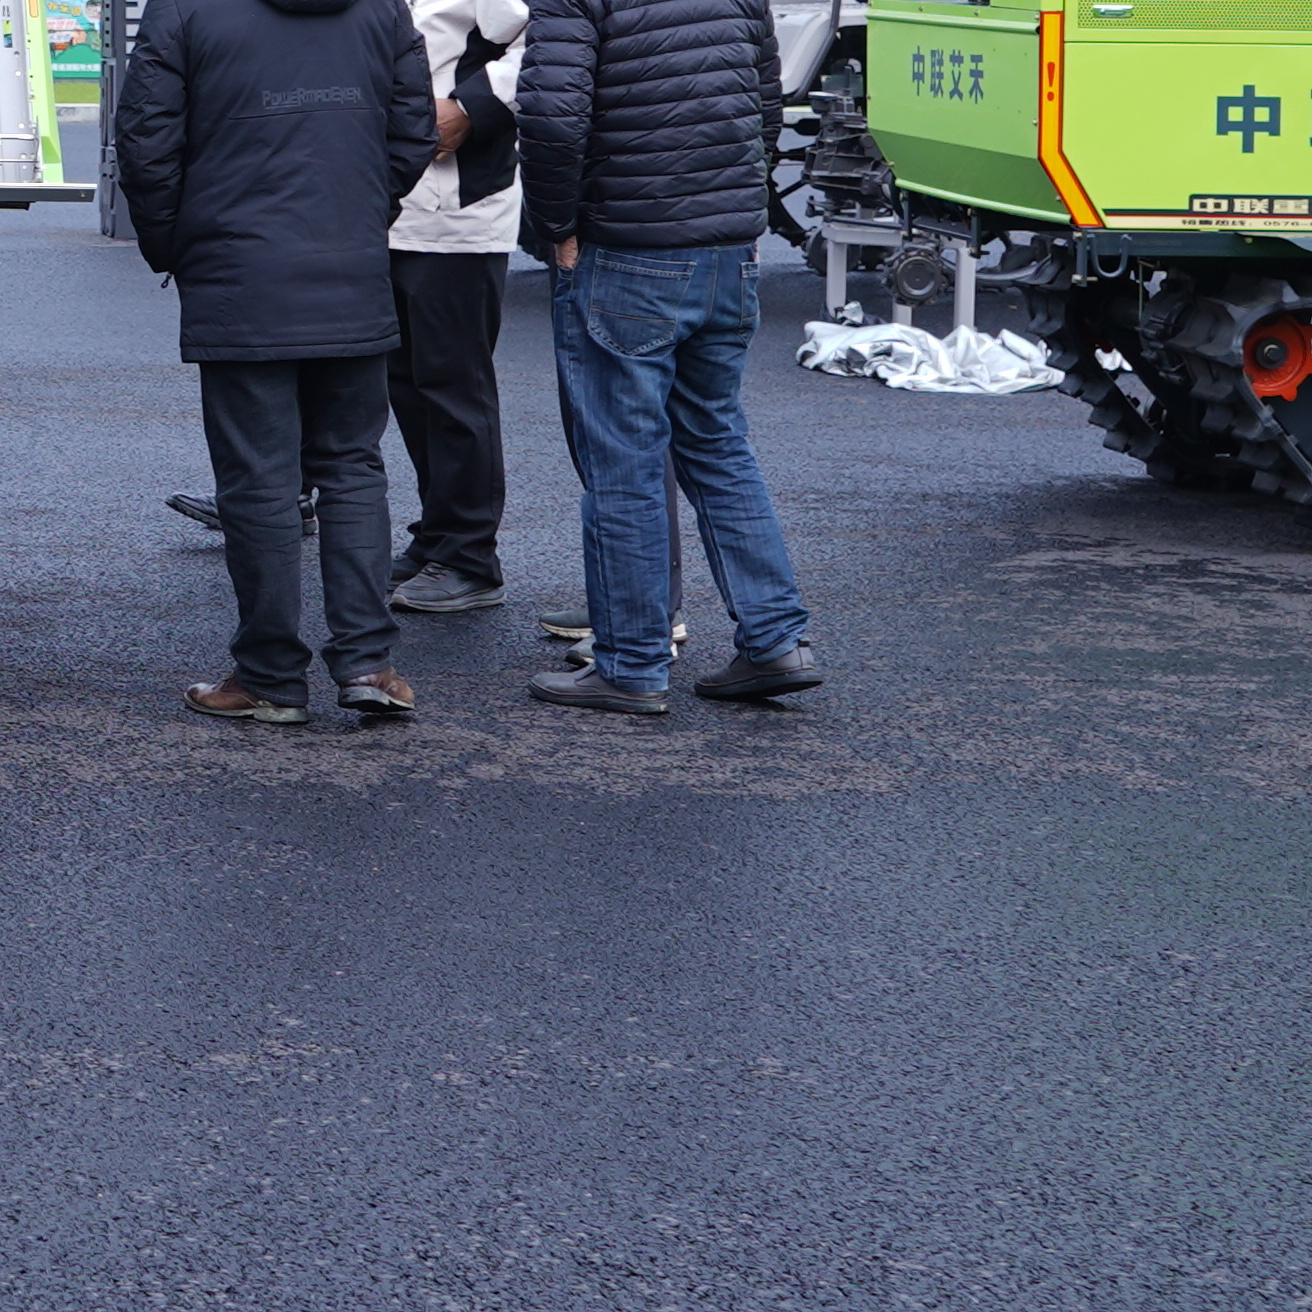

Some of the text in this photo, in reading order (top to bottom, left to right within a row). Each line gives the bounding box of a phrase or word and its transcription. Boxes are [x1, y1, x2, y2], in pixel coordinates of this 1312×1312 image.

[912, 45, 984, 104] 中联艾禾
[1216, 84, 1312, 154] 中
